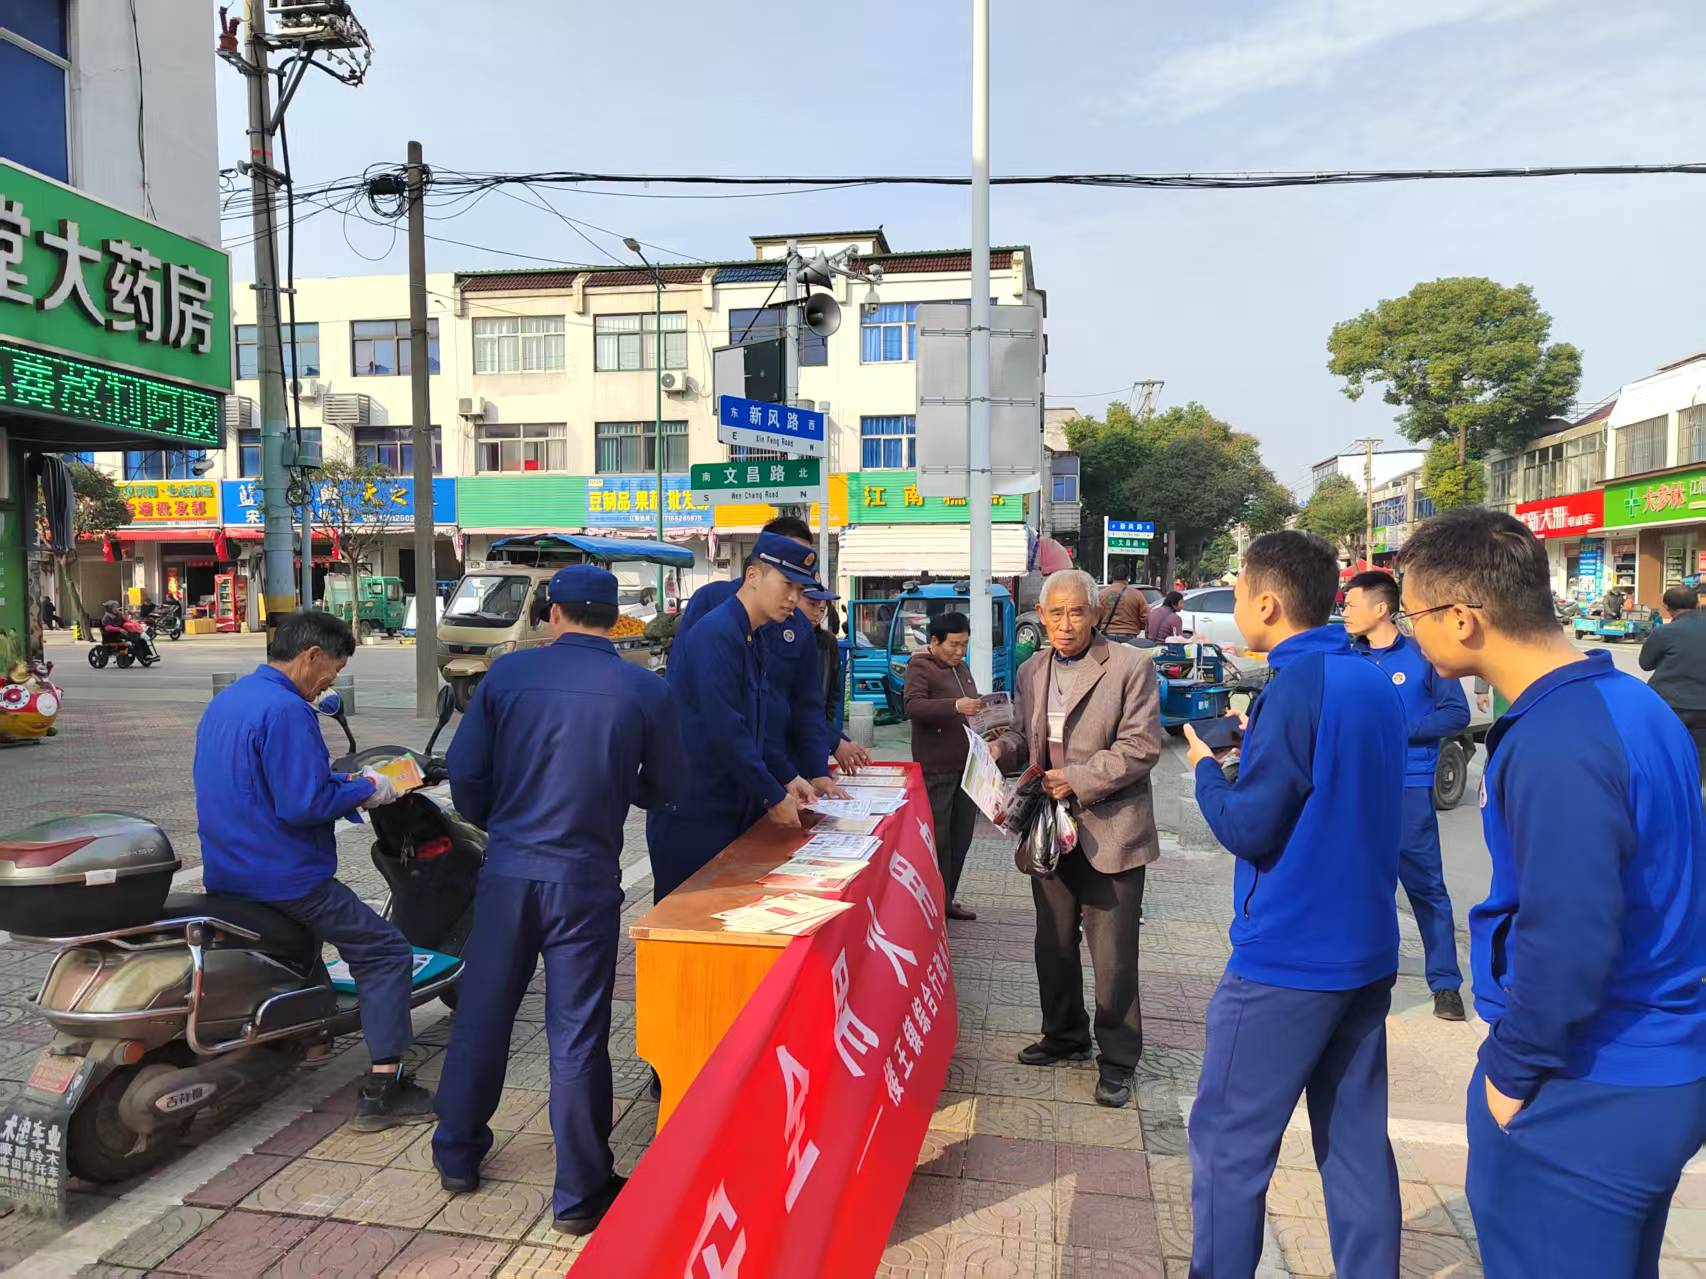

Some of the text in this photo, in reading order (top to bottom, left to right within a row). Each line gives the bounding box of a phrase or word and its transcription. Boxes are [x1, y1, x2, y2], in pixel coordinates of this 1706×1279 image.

[731, 405, 816, 431] 东 新风路 西
[732, 432, 737, 440] E
[756, 434, 765, 443] Xin
[767, 436, 780, 447] Feng
[782, 437, 794, 447] Road
[702, 464, 808, 484] 南 文昌路 北
[589, 490, 631, 511] 豆制品
[667, 490, 709, 511] 批发
[703, 494, 709, 502] S
[731, 491, 741, 499] Wen
[745, 491, 762, 500] Chang
[765, 490, 779, 499] Road
[1643, 481, 1685, 512] 大参林
